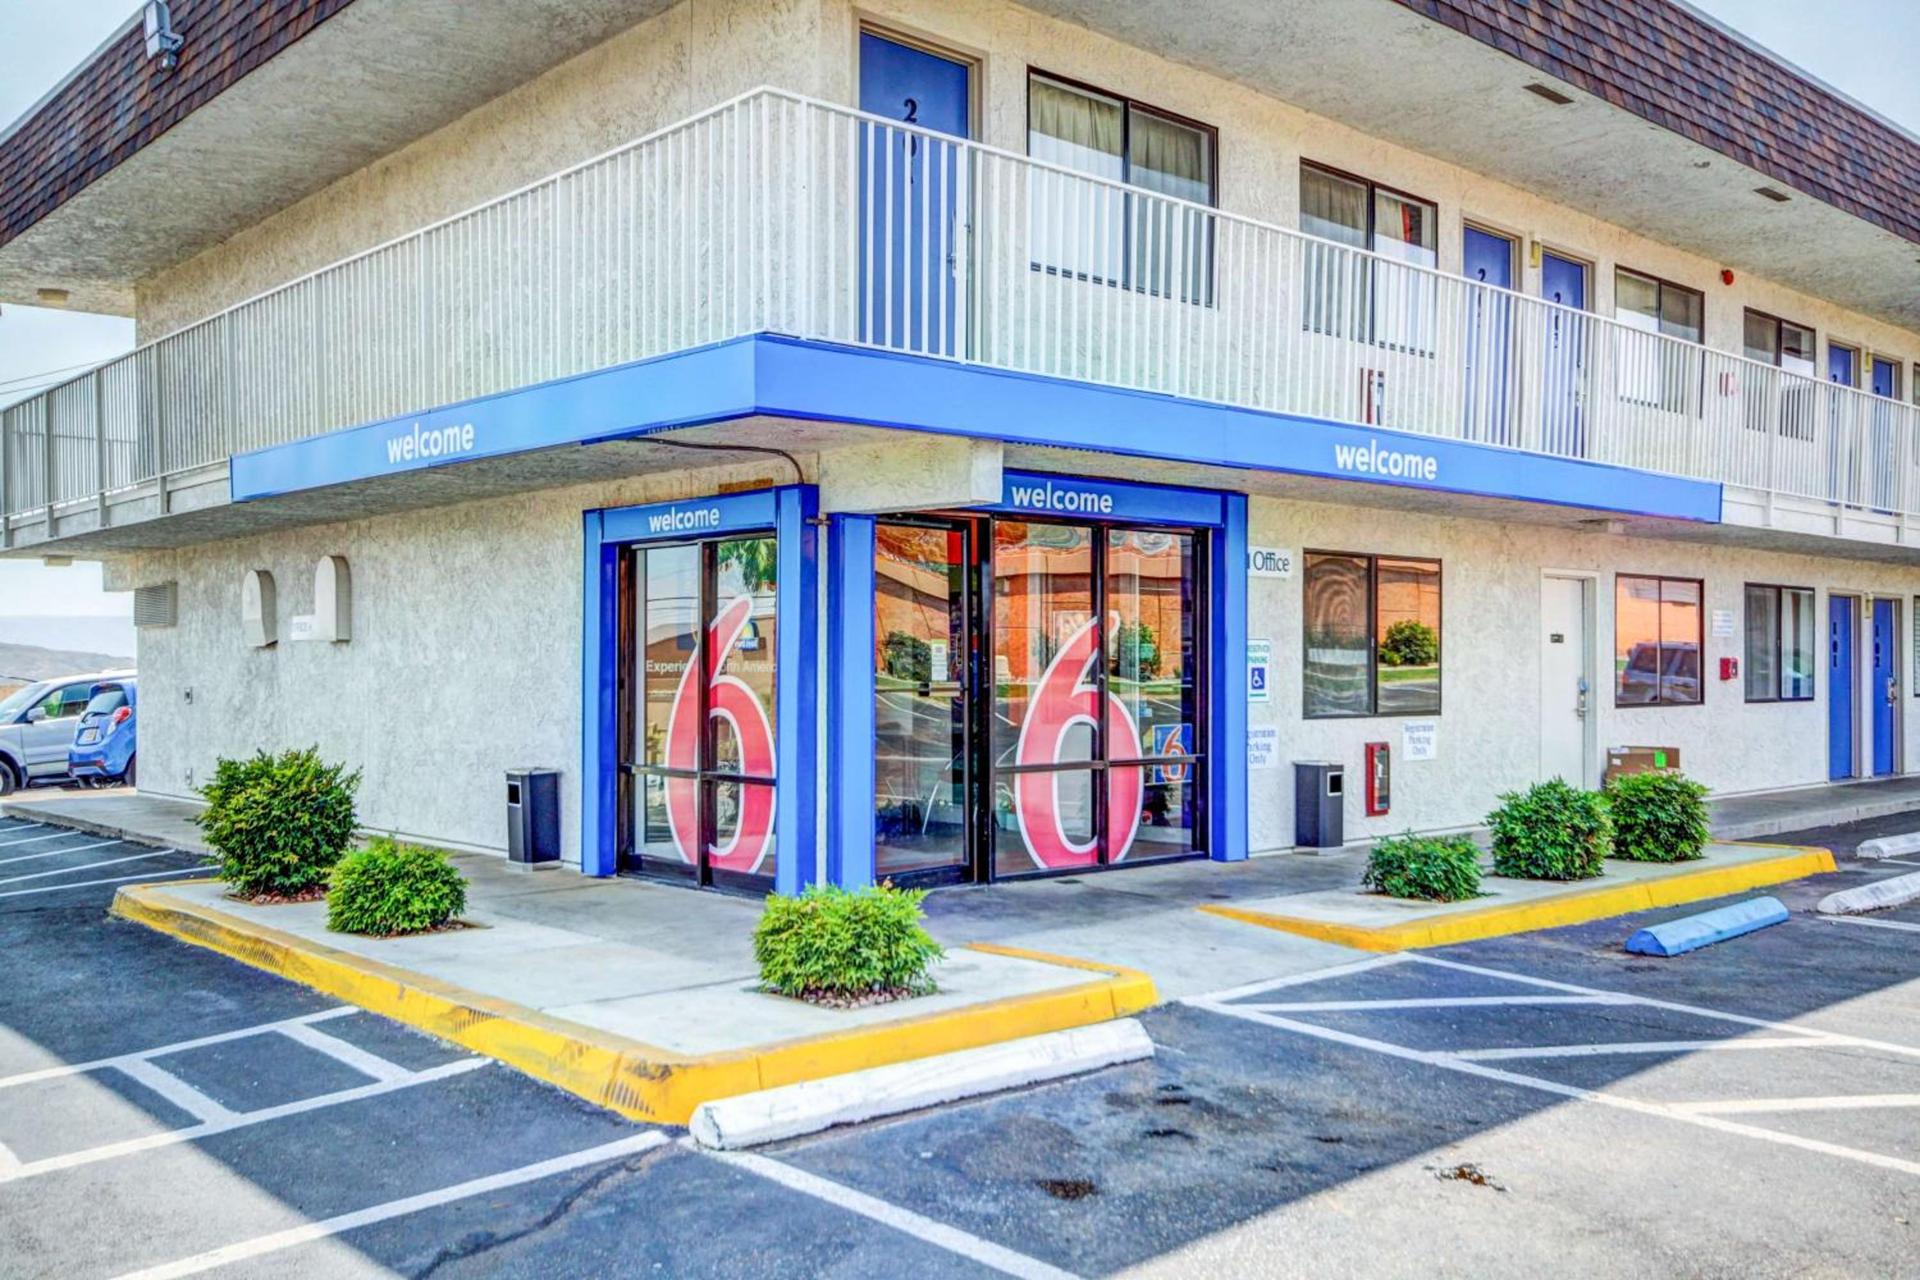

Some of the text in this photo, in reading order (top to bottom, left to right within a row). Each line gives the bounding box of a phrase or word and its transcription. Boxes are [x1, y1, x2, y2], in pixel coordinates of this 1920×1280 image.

[387, 422, 474, 464] welcome
[1335, 438, 1438, 481] welcome
[1011, 481, 1113, 513] welcome
[648, 506, 720, 533] welcome
[1253, 550, 1290, 572] Office
[665, 594, 777, 874] 6
[1015, 610, 1143, 869] 6
[1247, 741, 1272, 753] arking
